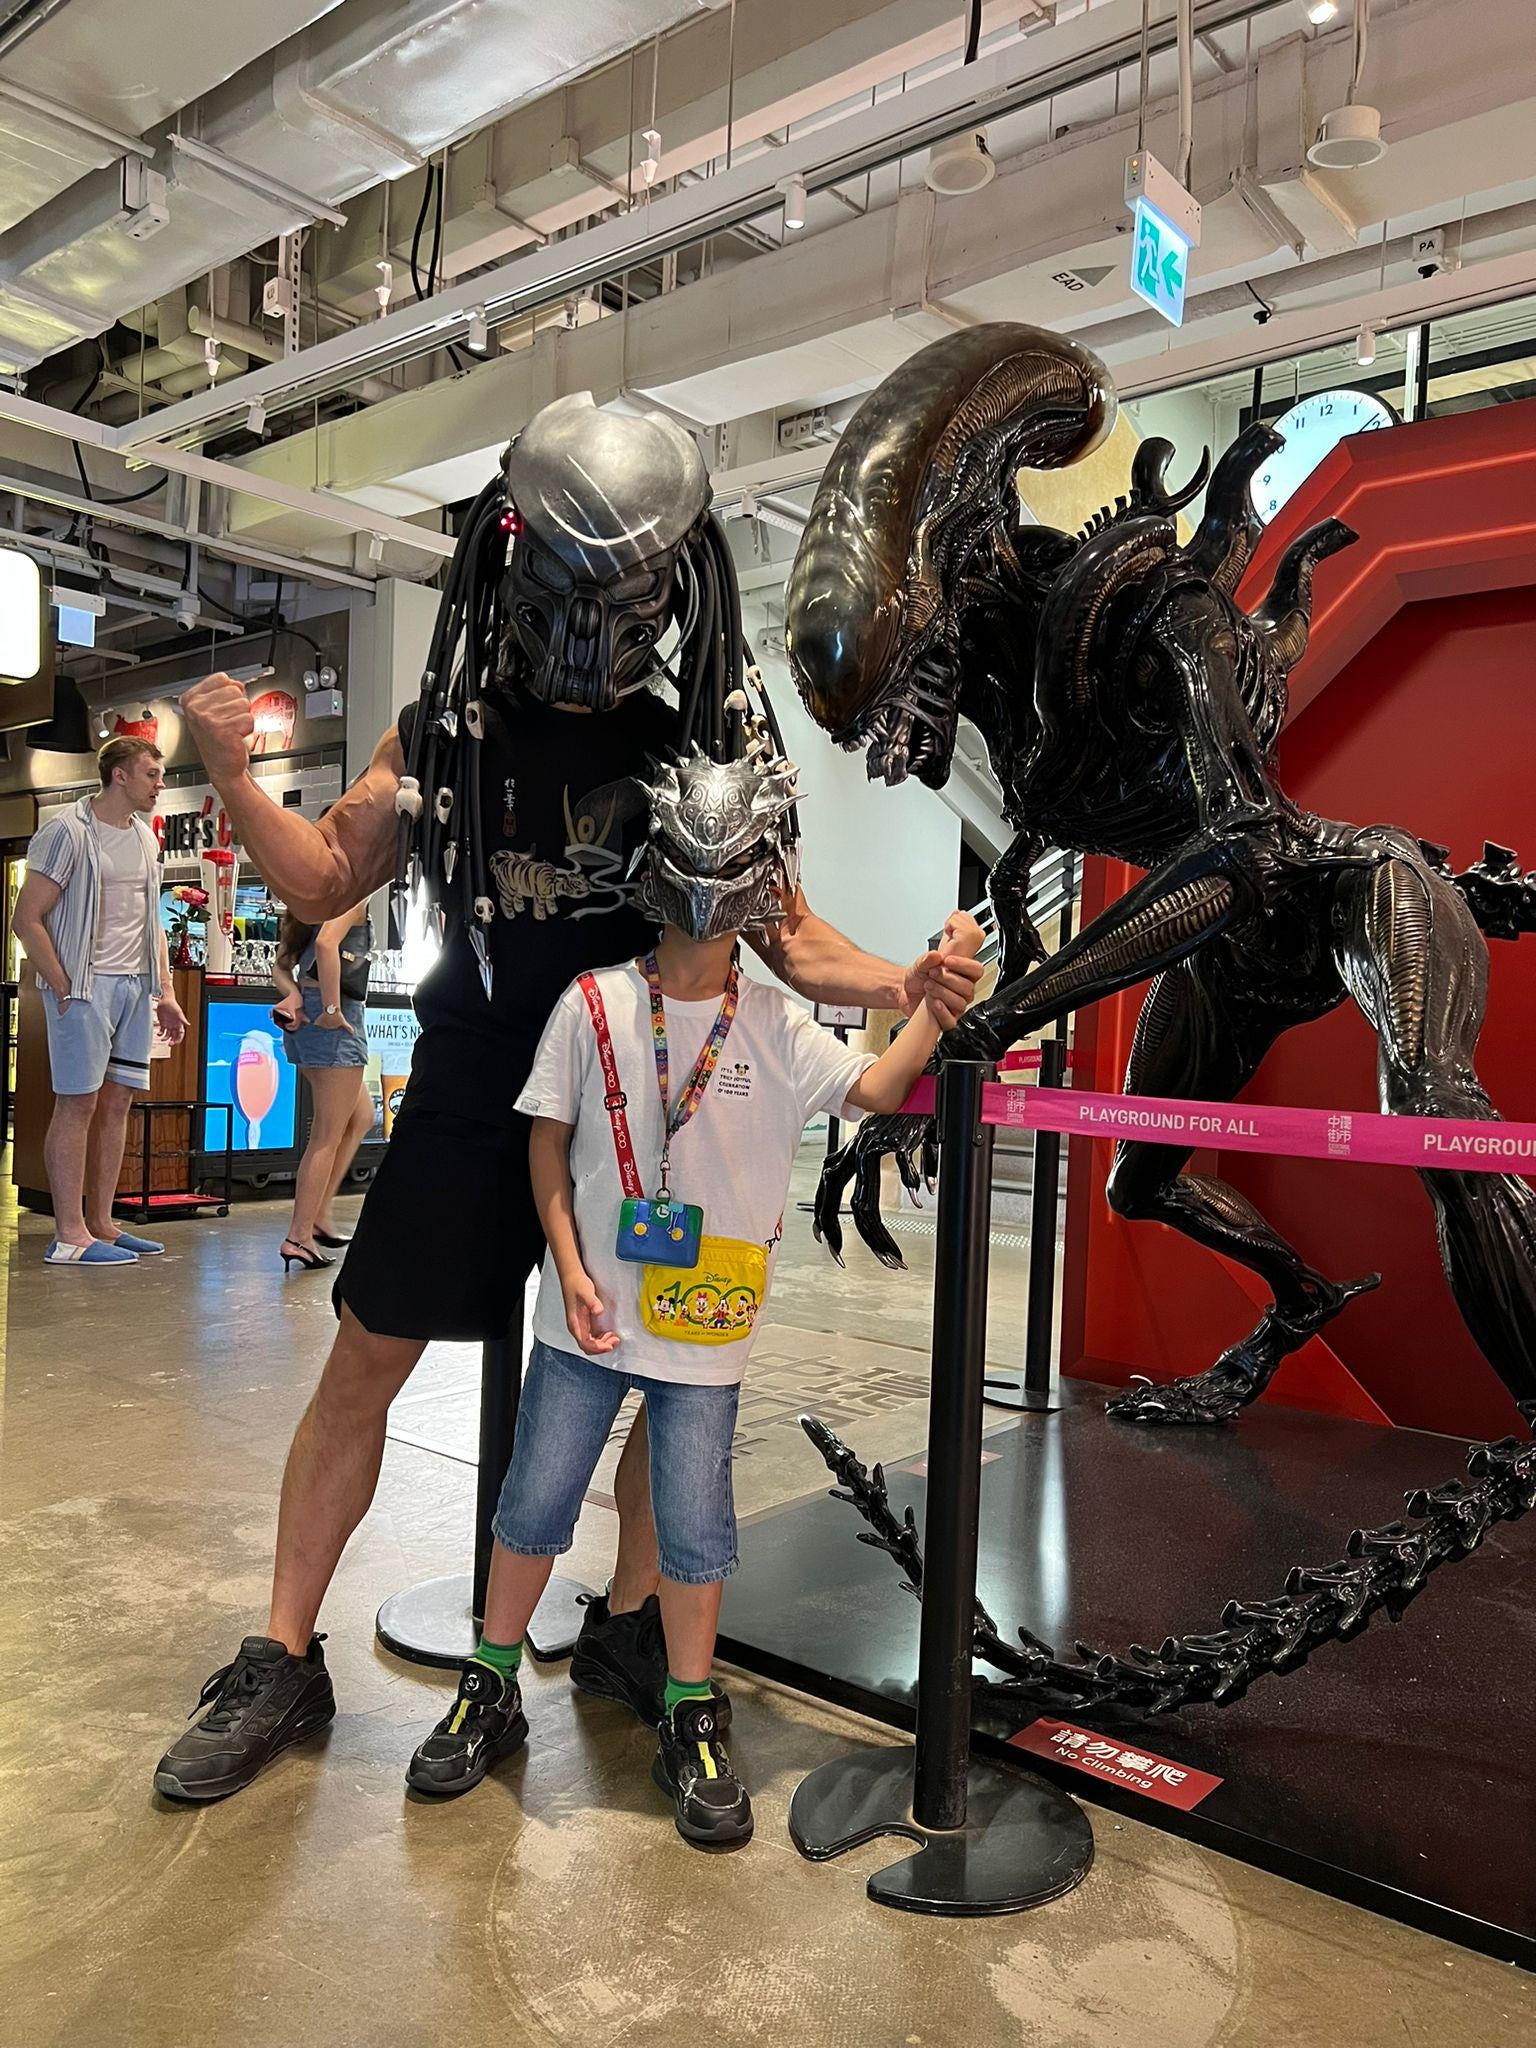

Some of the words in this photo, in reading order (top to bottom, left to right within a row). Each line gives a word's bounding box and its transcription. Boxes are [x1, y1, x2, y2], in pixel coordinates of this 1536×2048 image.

[1419, 240, 1435, 252] PA
[1051, 272, 1084, 292] EAD
[1320, 404, 1333, 416] 12
[1296, 417, 1305, 429] 11
[1263, 474, 1271, 485] 9
[1269, 500, 1277, 510] 8
[380, 1014, 412, 1022] HERE'S
[366, 1024, 408, 1040] WHAT'S
[410, 1026, 422, 1039] NE
[1079, 1105, 1185, 1130] PLAYGROUND
[1189, 1115, 1222, 1133] FOR
[1226, 1118, 1260, 1137] ALL
[660, 1206, 668, 1216] L
[703, 1271, 732, 1286] Disney
[1050, 1728, 1189, 1787] 請勿攀爬
[1055, 1747, 1077, 1760] No
[1081, 1756, 1154, 1789] Climbing
